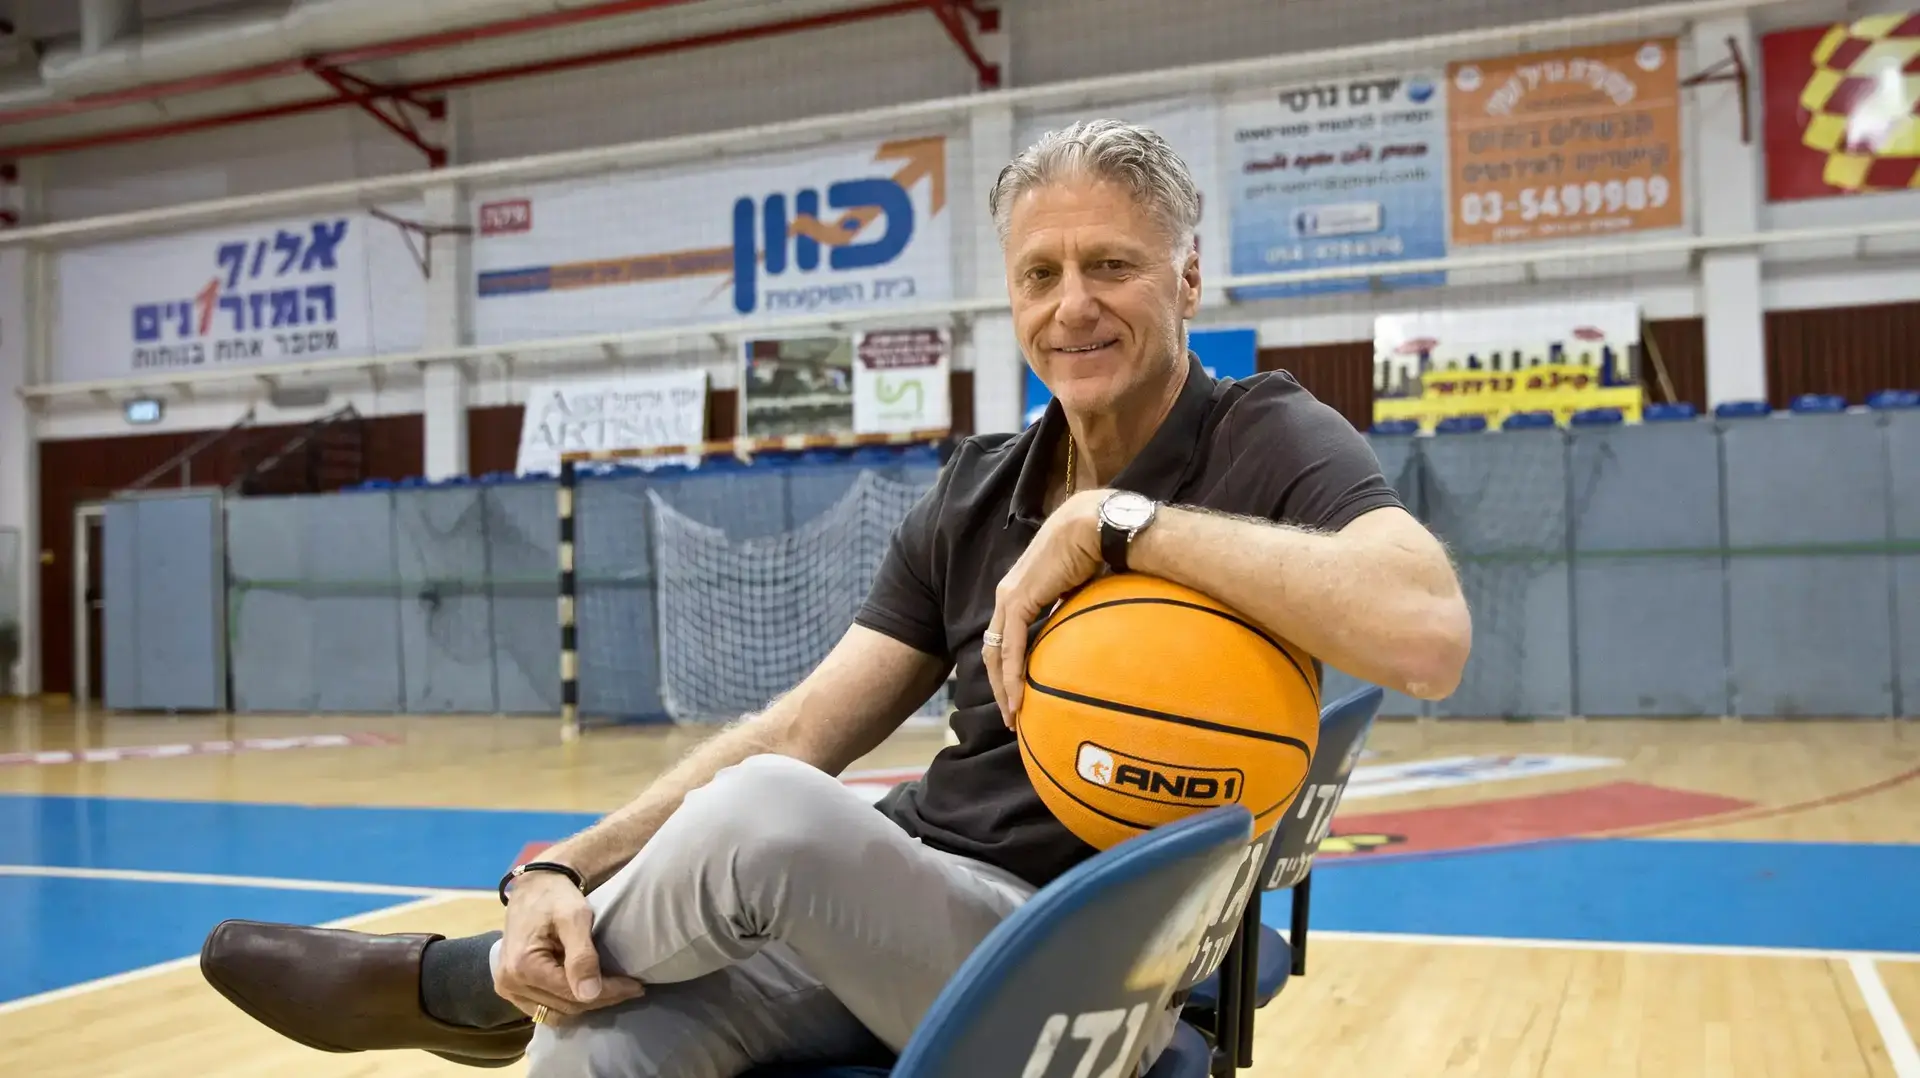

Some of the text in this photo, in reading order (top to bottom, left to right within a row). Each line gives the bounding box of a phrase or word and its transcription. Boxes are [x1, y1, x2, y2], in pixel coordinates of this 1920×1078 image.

[216, 219, 349, 290] אלוף
[873, 275, 917, 301] בית
[213, 337, 264, 363] אחת
[273, 329, 339, 356] מספר
